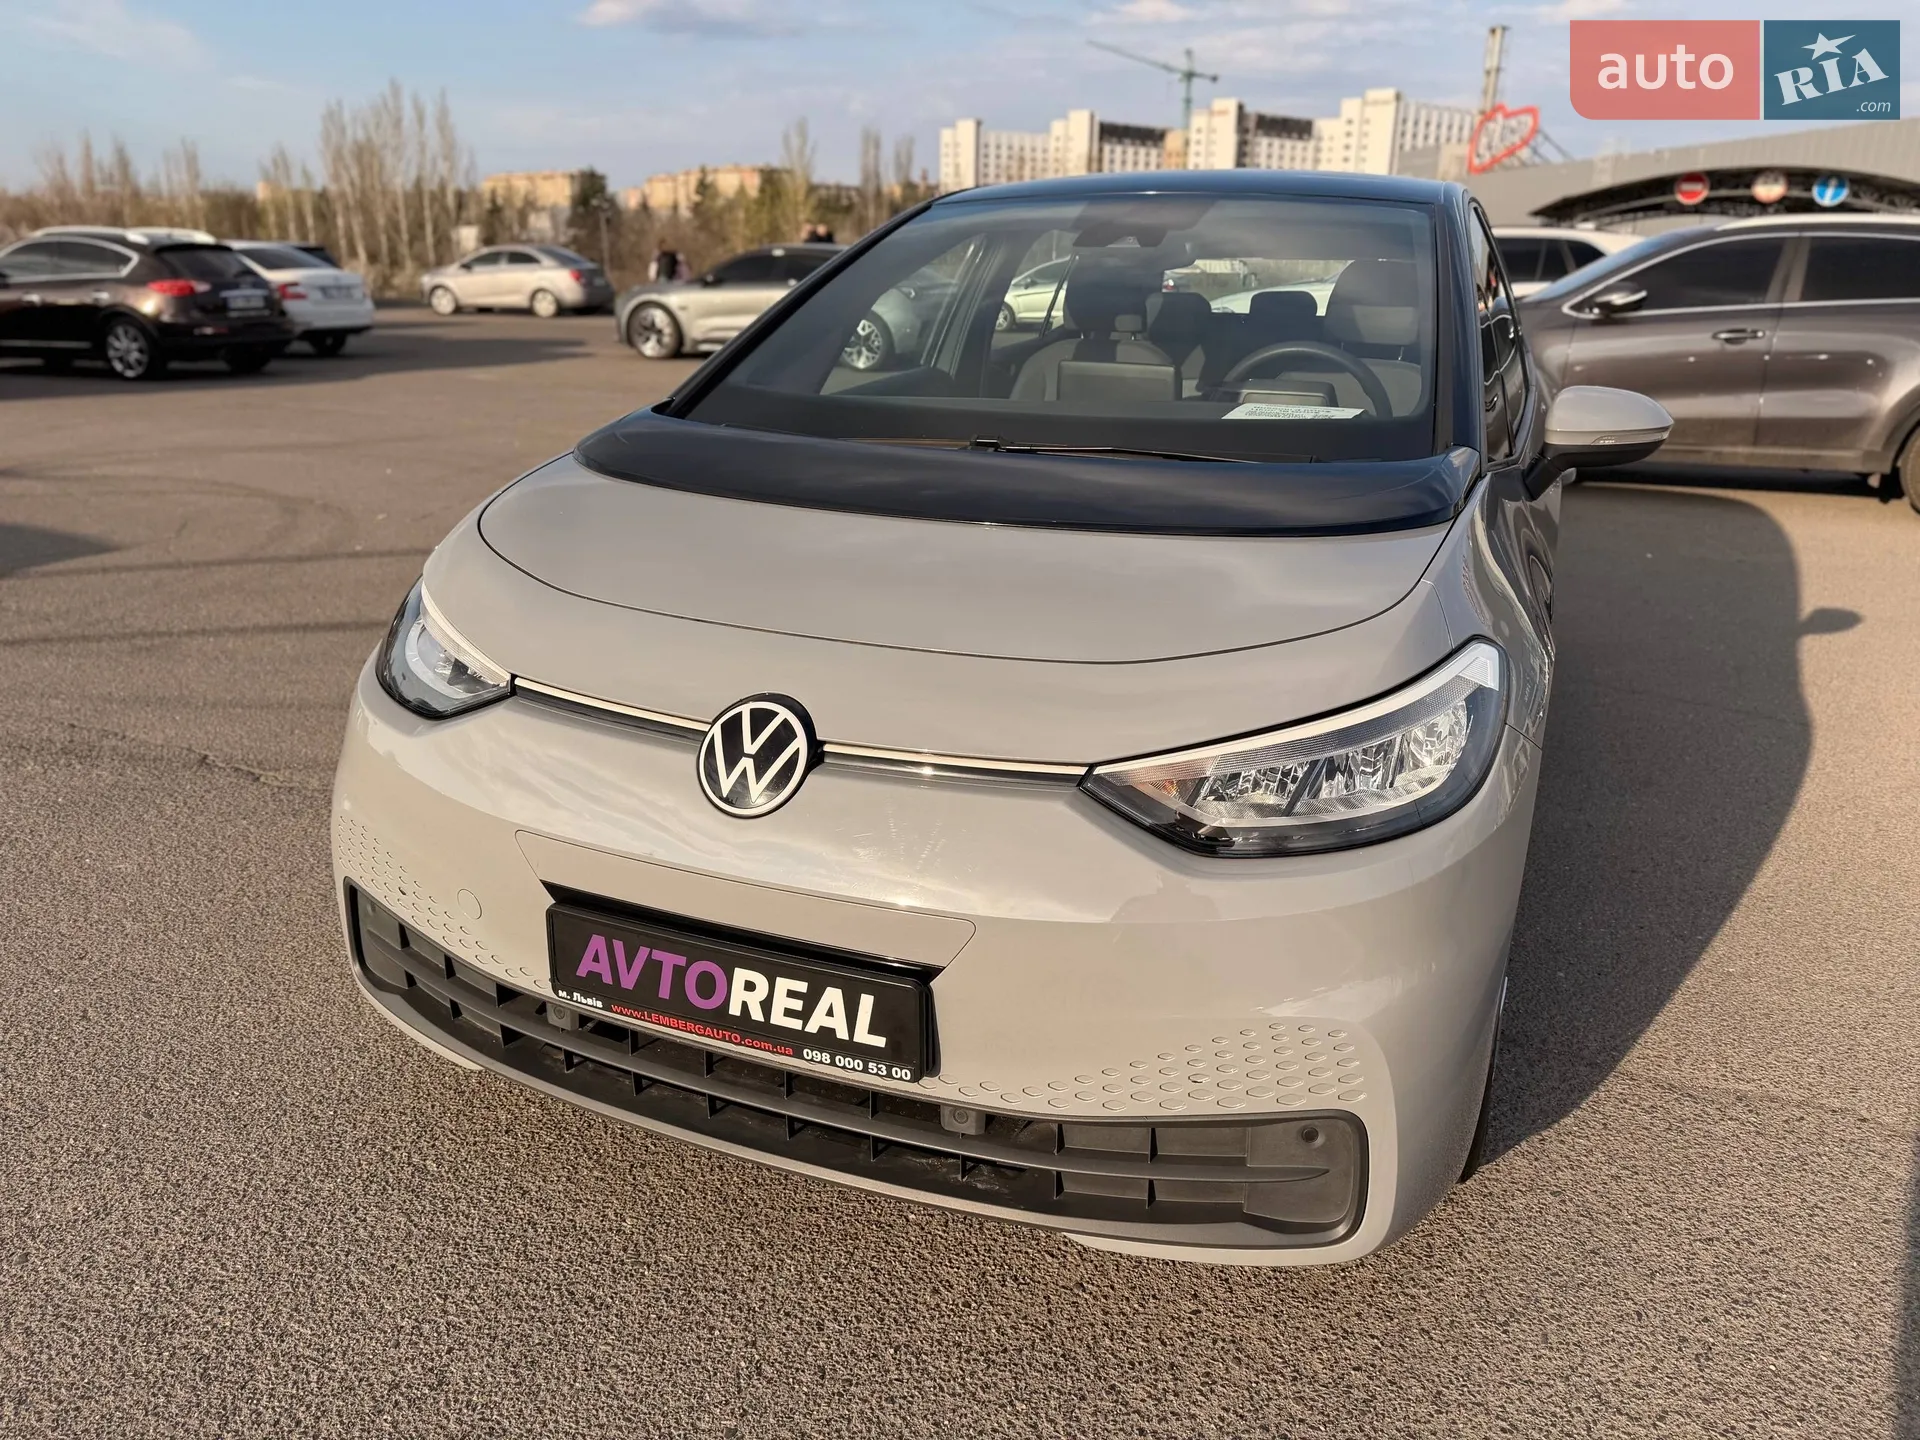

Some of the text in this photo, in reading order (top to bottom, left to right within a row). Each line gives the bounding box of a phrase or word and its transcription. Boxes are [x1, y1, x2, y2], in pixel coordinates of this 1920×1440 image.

[558, 990, 603, 1007] м. Львів
[576, 934, 886, 1047] AVTOREAL
[611, 1004, 794, 1056] www.LEMBERGAUTO.com.ua
[803, 1048, 911, 1080] 098 000 53 00
